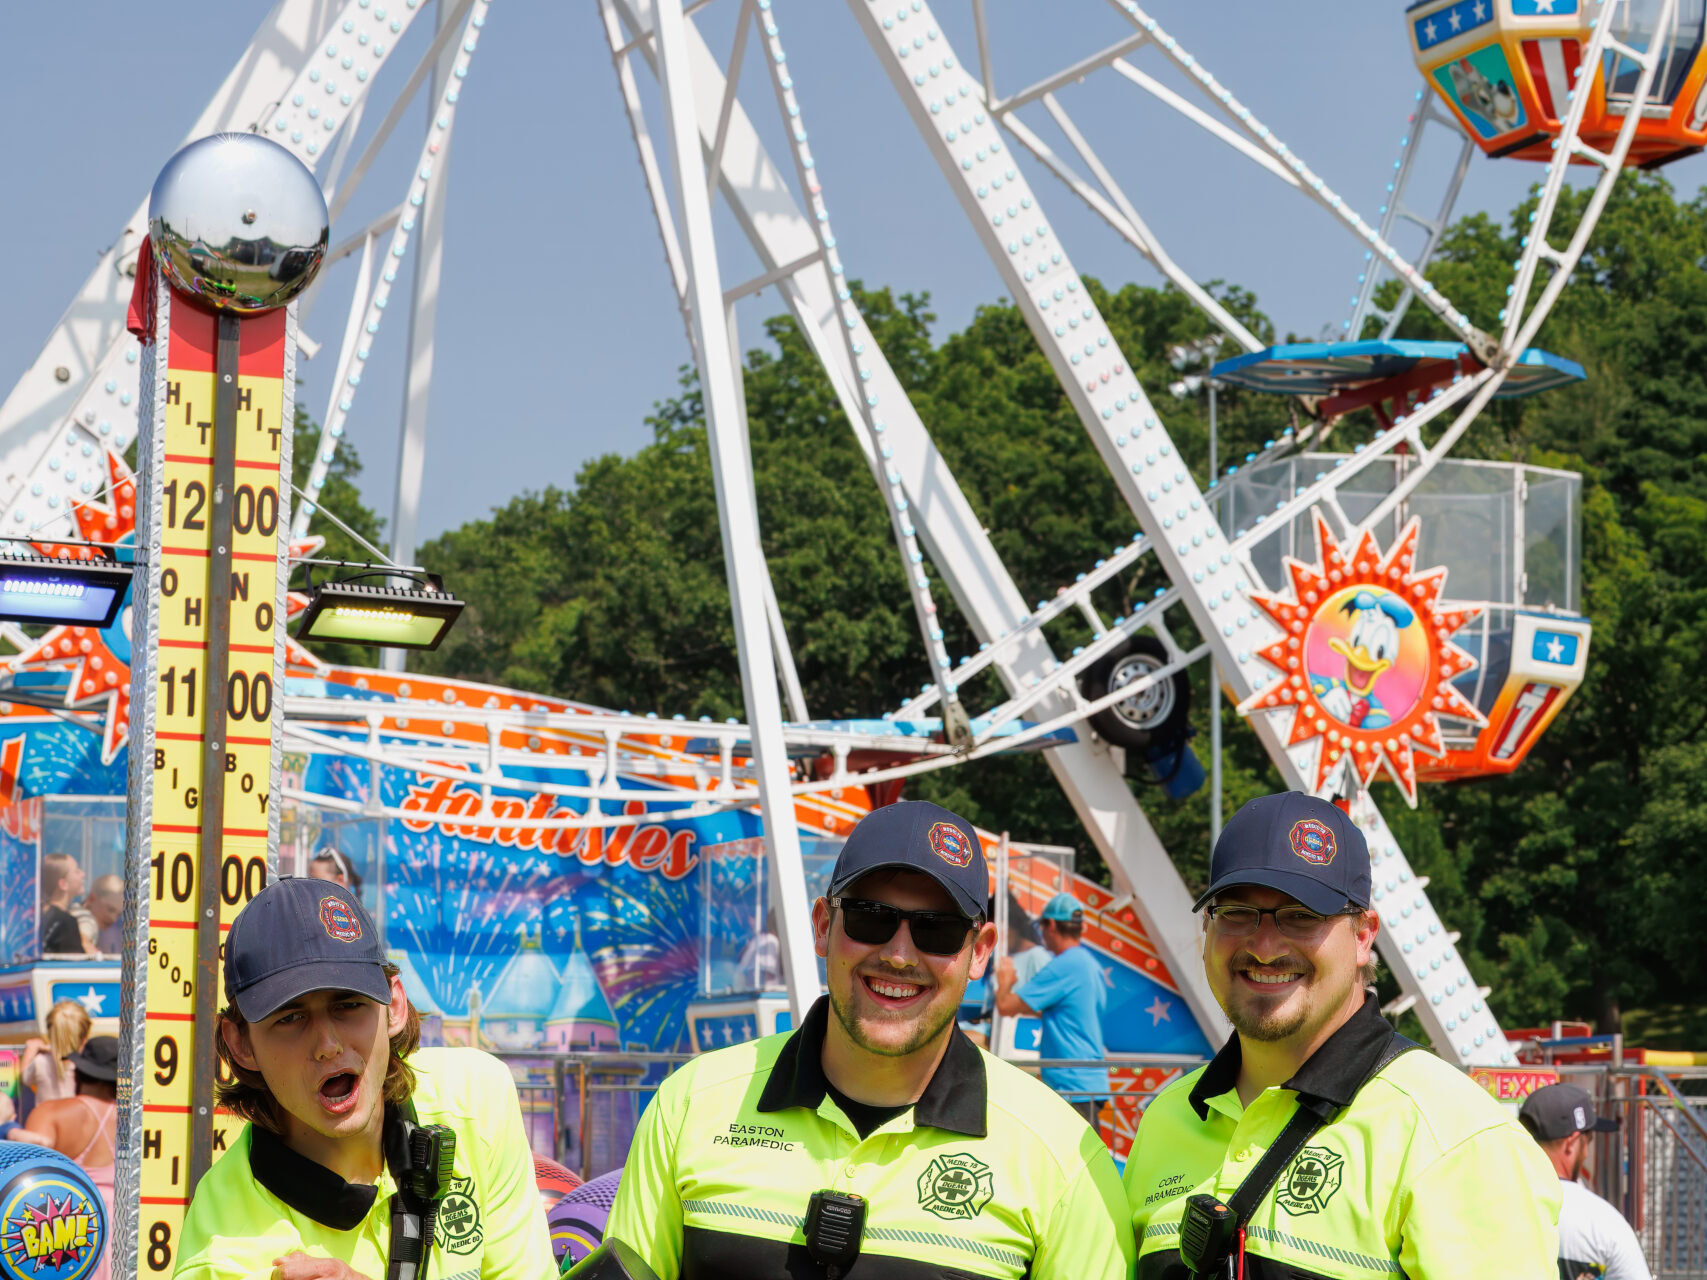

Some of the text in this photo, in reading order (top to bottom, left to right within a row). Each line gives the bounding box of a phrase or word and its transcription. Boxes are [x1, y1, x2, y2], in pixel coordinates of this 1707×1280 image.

[166, 382, 281, 451] HIT HIT
[164, 479, 278, 537] 12 00
[161, 568, 273, 632] OH NO
[160, 666, 272, 722] 11 00
[154, 749, 269, 813] BIG BOY
[151, 851, 194, 903] 10
[148, 938, 192, 997] GOOD
[154, 1034, 178, 1086] 9
[713, 1135, 794, 1152] PARAMEDIC
[729, 1123, 784, 1137] EASTON
[143, 1129, 179, 1185] HI
[946, 1158, 968, 1168] MEDIC
[1158, 1173, 1185, 1188] CORY
[932, 1204, 955, 1214] MEDIC
[1145, 1184, 1194, 1206] PARAMEDIC
[20, 1213, 89, 1258] BAM!
[147, 1220, 171, 1272] 8
[450, 1238, 472, 1250] MEDIC
